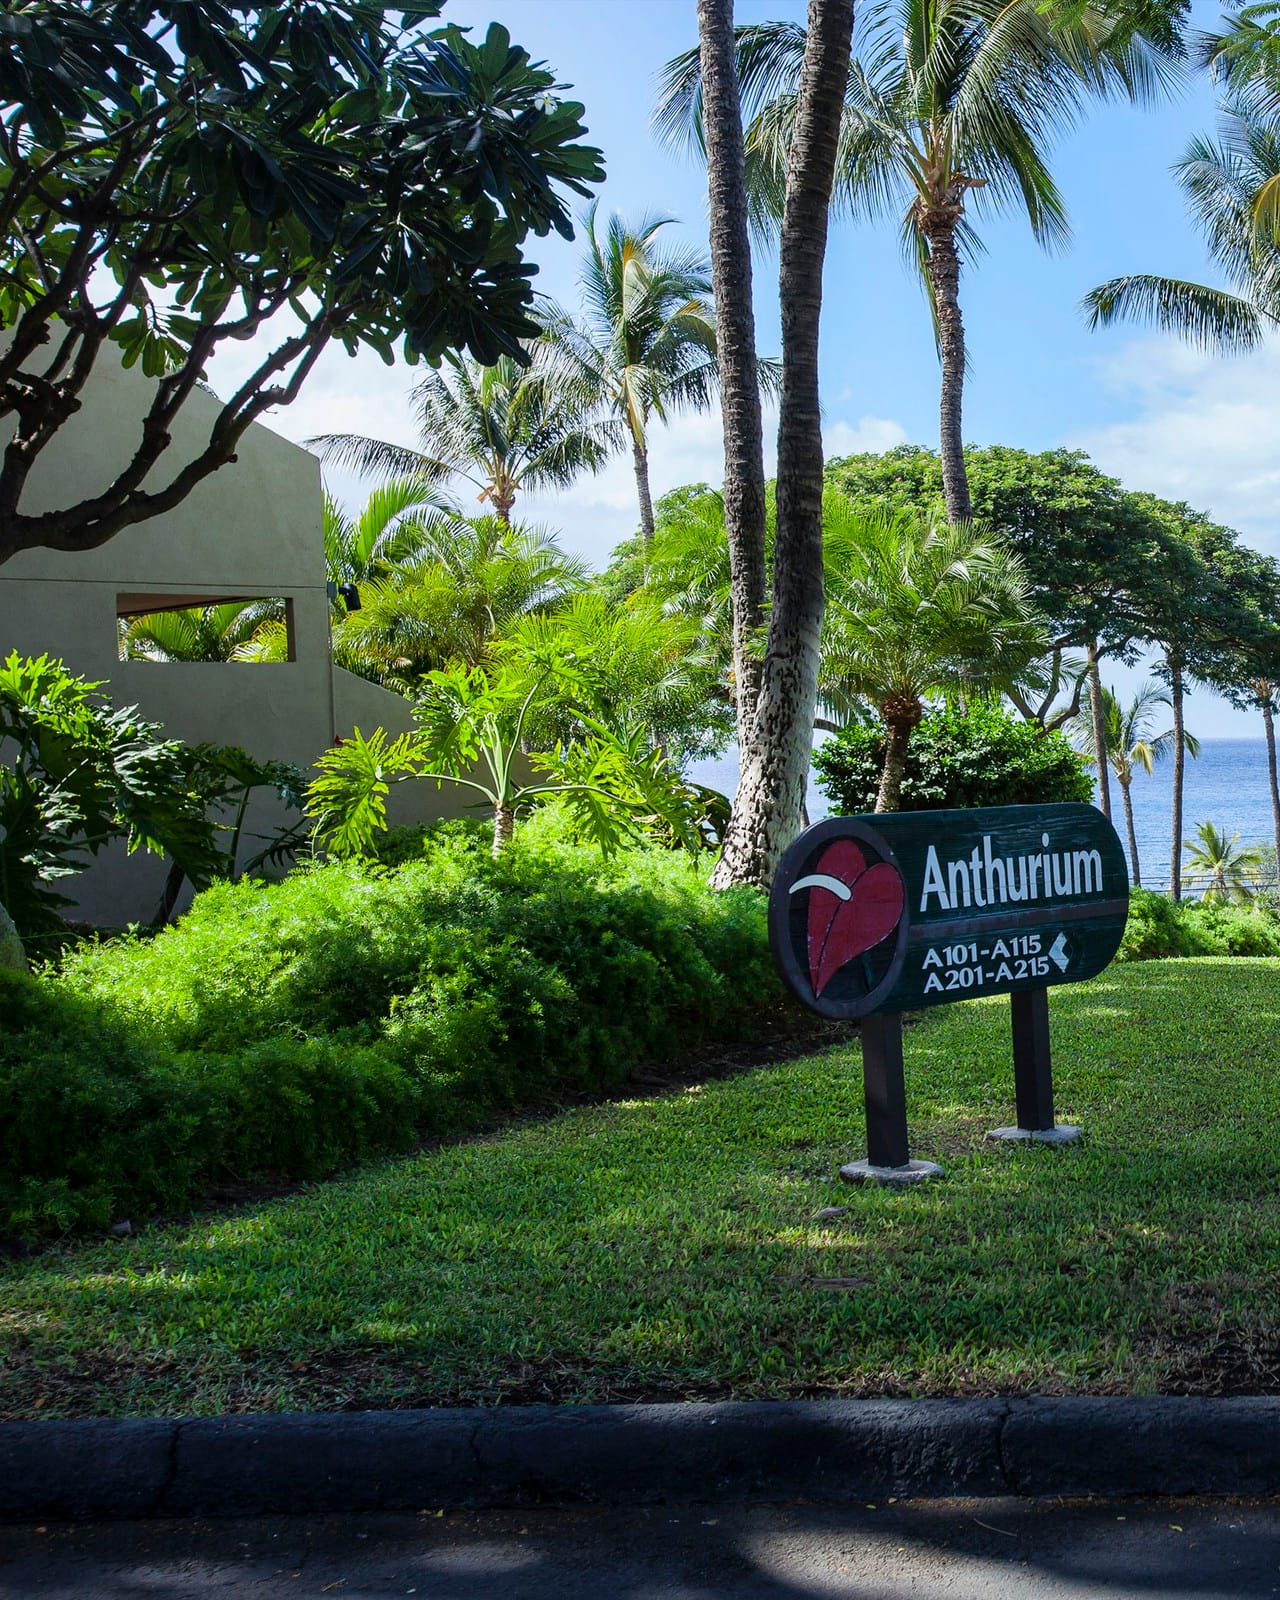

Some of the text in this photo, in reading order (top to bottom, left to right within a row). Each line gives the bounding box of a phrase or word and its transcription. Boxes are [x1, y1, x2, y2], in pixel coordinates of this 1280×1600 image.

[920, 832, 1103, 912] Anthurium
[923, 934, 1042, 970] A101-A115
[923, 955, 1050, 994] A201-A215
